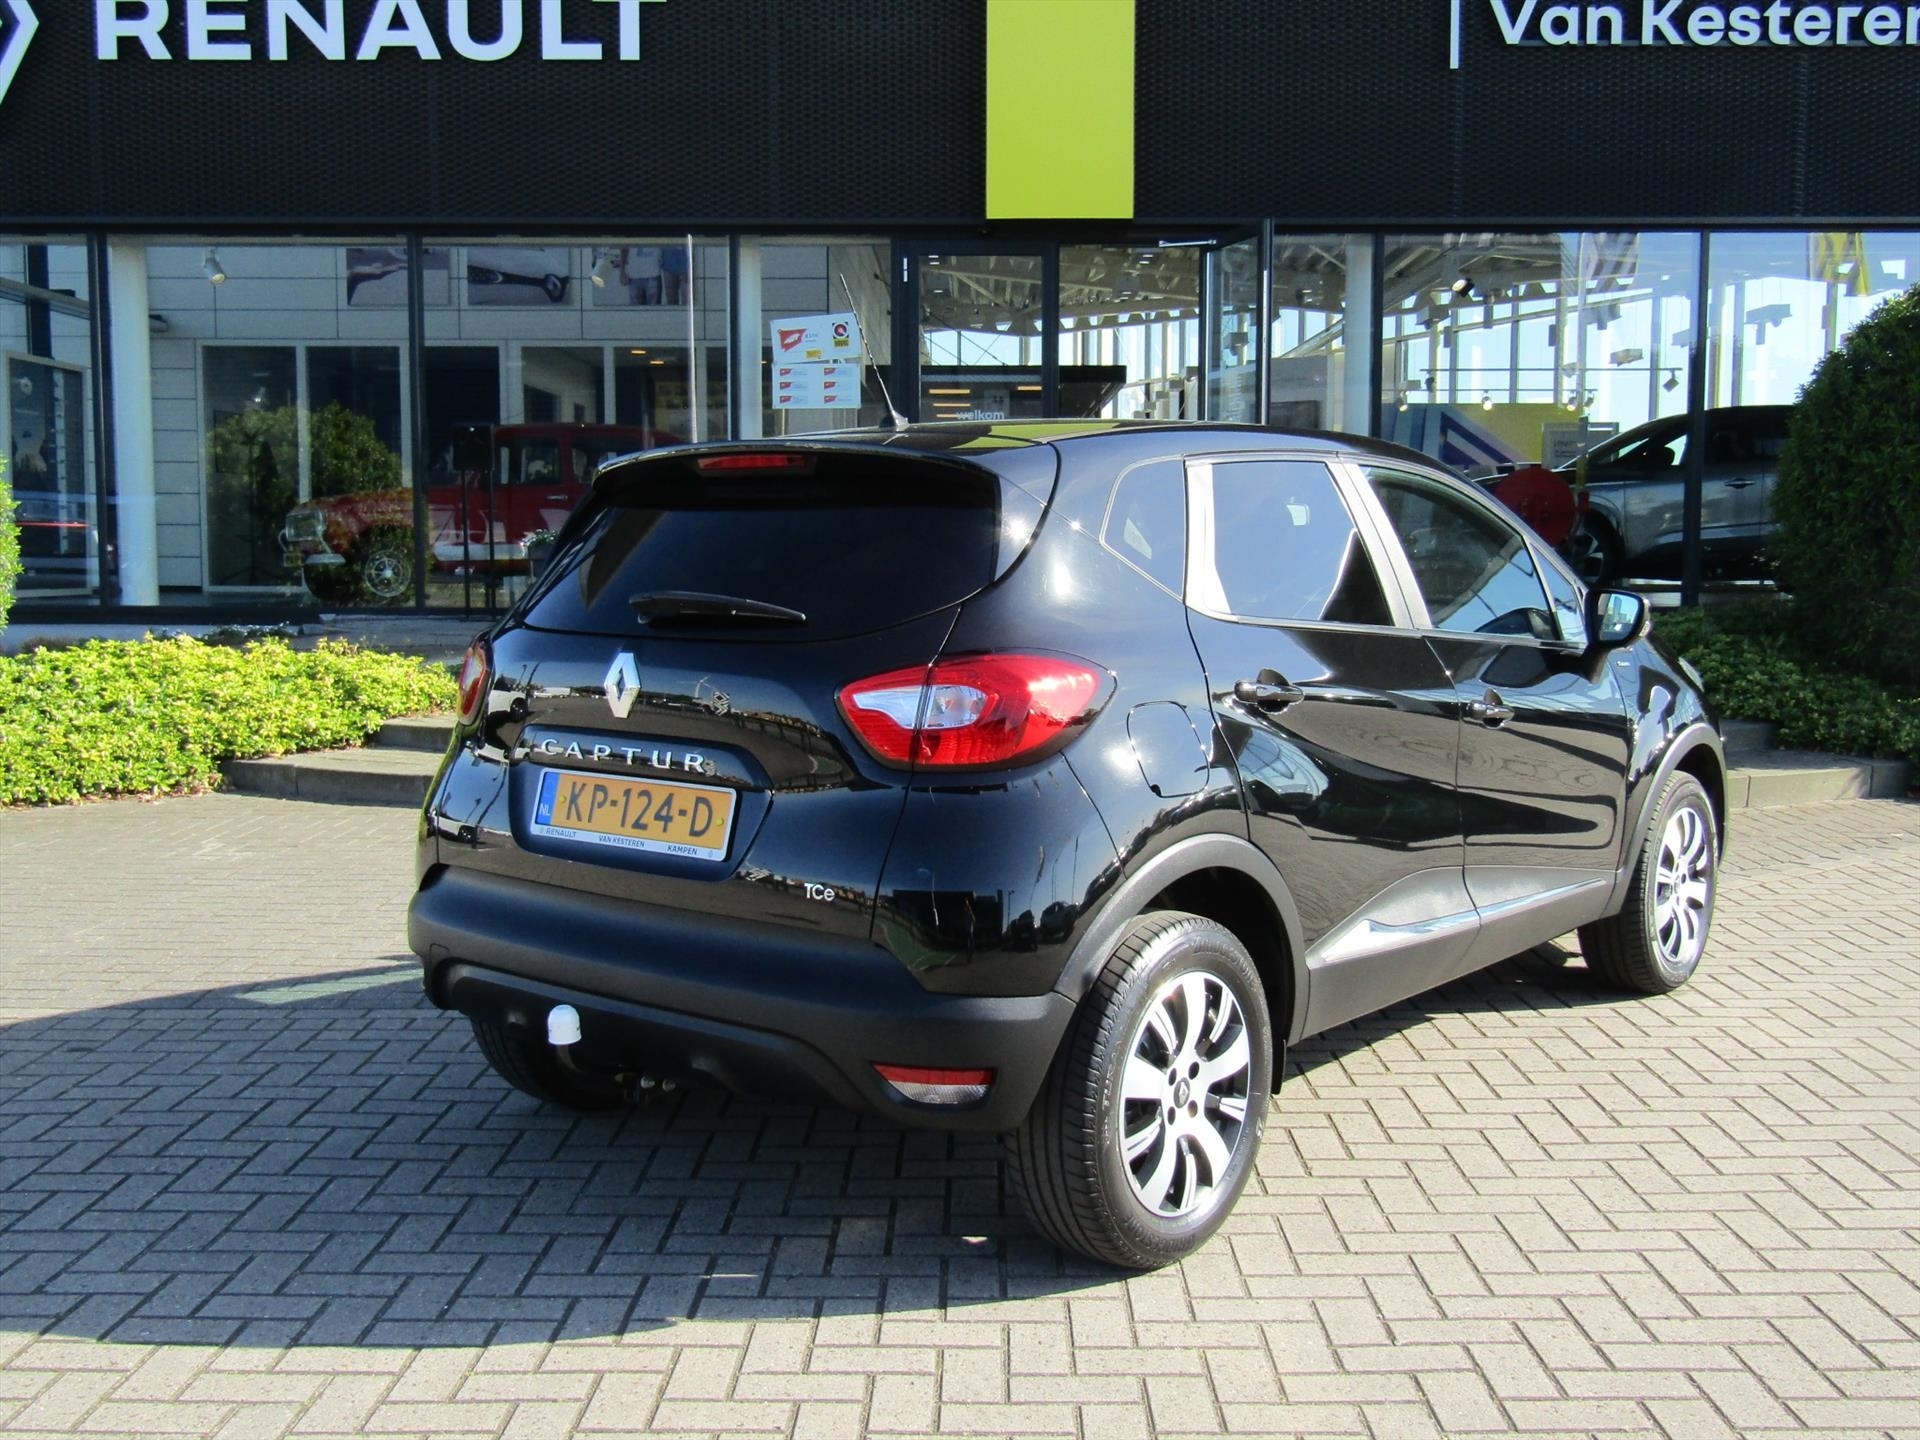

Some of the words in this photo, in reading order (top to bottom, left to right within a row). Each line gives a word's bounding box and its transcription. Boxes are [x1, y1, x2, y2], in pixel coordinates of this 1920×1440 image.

[95, 0, 667, 61] RENAULT
[1489, 0, 1623, 46] Van
[956, 409, 1005, 420] welkom
[541, 738, 706, 773] CAPTUR
[539, 802, 551, 817] NL
[566, 781, 713, 838] KP-124-D
[545, 827, 577, 839] RENAULT
[598, 834, 614, 844] VAN
[612, 835, 645, 849] KESTEREN
[667, 844, 698, 856] KAMPEN
[804, 882, 836, 902] TCe
